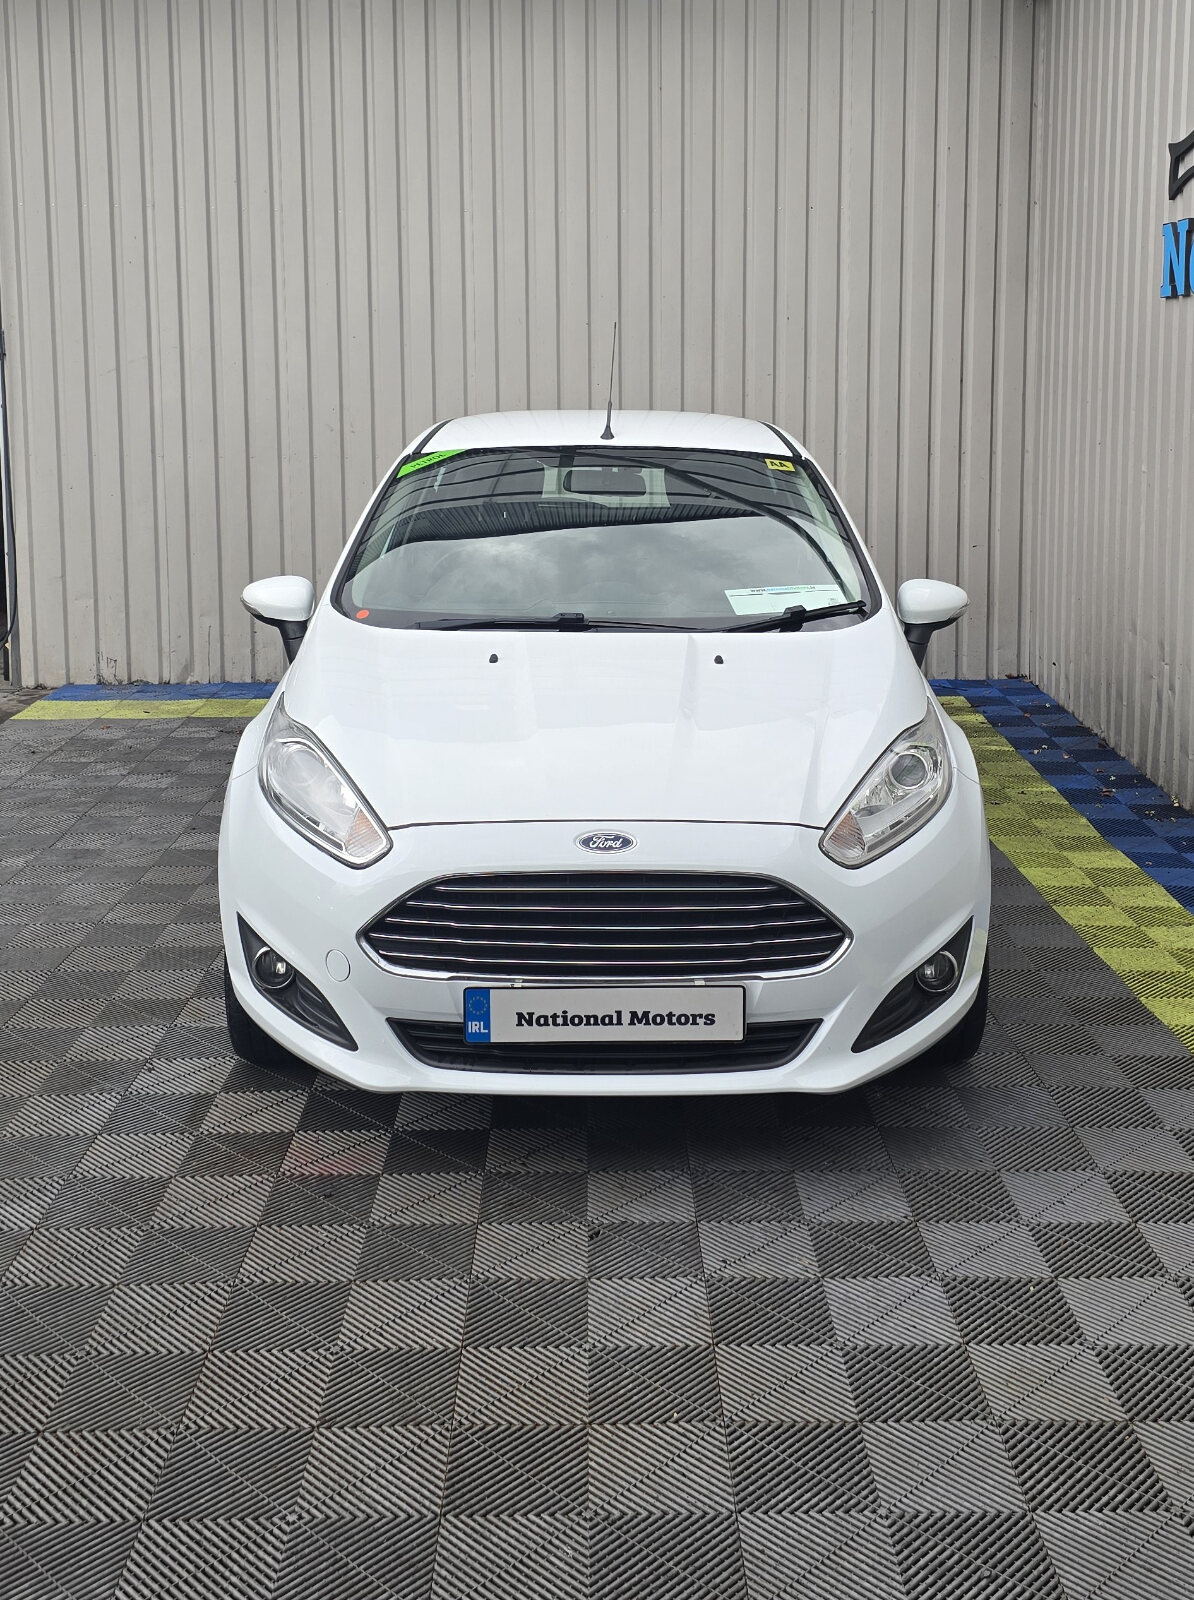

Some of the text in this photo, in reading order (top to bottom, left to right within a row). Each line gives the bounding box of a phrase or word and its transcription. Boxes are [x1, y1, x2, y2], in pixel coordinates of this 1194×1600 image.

[1160, 219, 1194, 298] N
[769, 461, 790, 469] AA
[589, 835, 623, 848] Ford
[515, 1010, 716, 1027] National Motors
[468, 1021, 488, 1033] IRL
